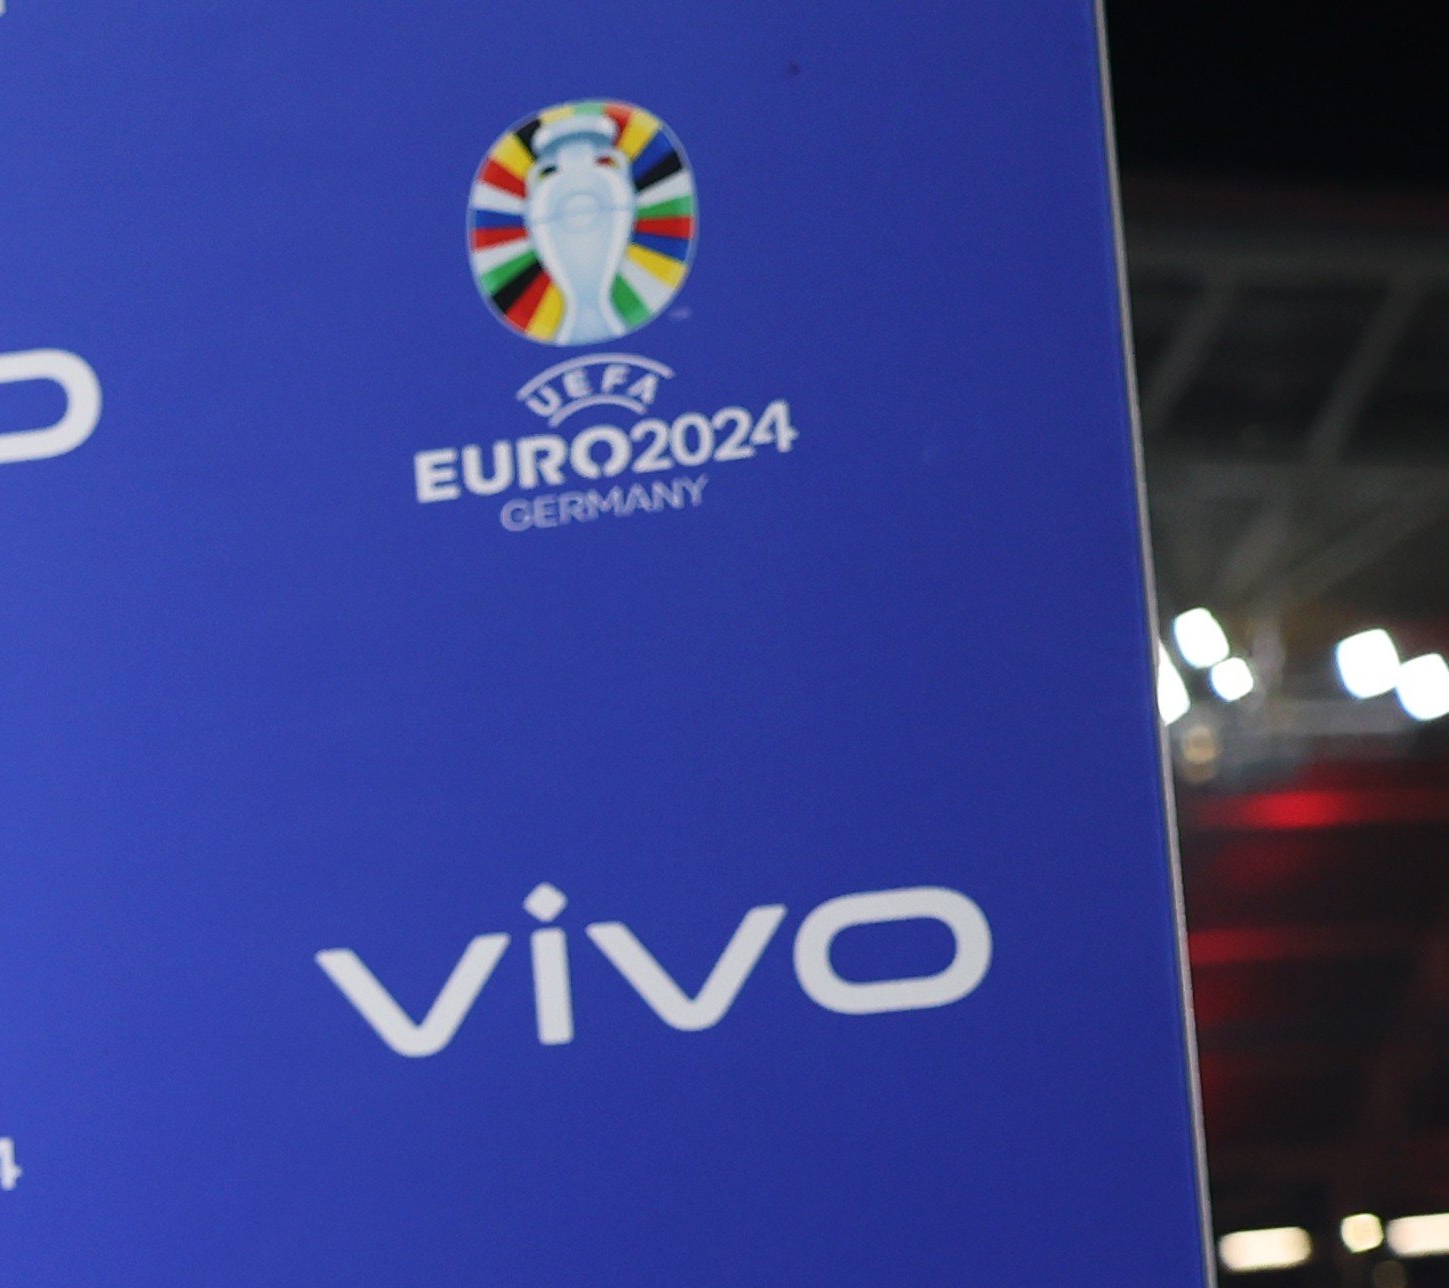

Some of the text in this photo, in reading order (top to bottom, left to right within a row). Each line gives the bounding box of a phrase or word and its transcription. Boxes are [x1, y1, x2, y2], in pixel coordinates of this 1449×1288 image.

[525, 363, 660, 417] UEFA
[500, 474, 708, 531] GERMANY
[314, 883, 993, 1058] vivo
